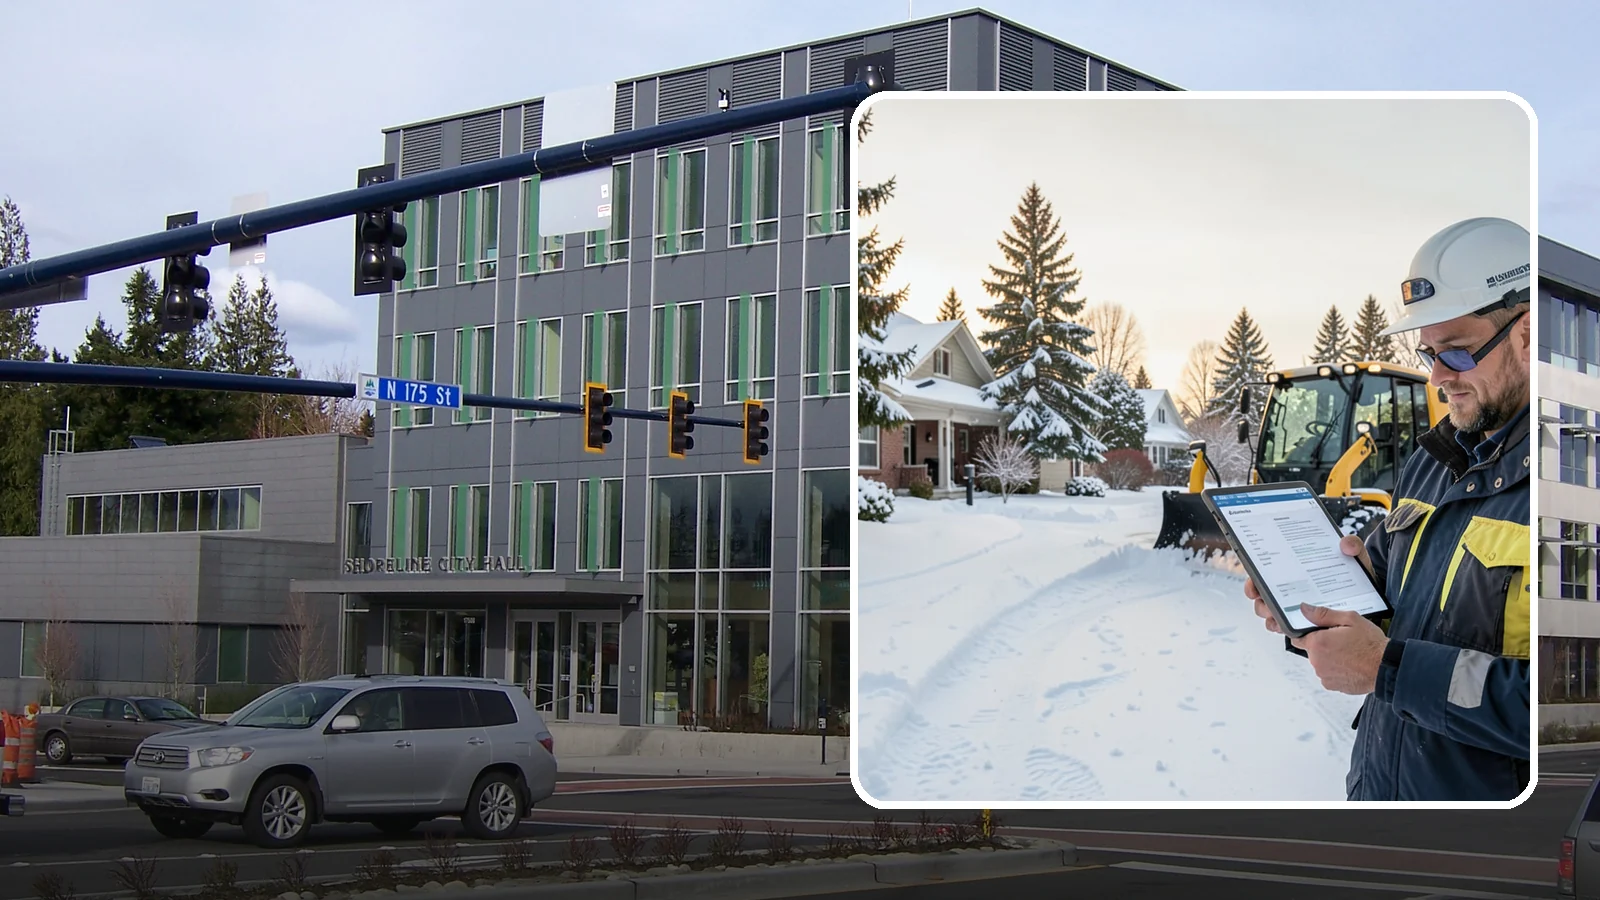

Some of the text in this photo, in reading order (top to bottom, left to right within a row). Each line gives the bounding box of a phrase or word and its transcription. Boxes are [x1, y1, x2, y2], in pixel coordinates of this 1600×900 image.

[387, 380, 451, 406] N 175 St
[344, 555, 525, 574] SHORELINE CITY HALL
